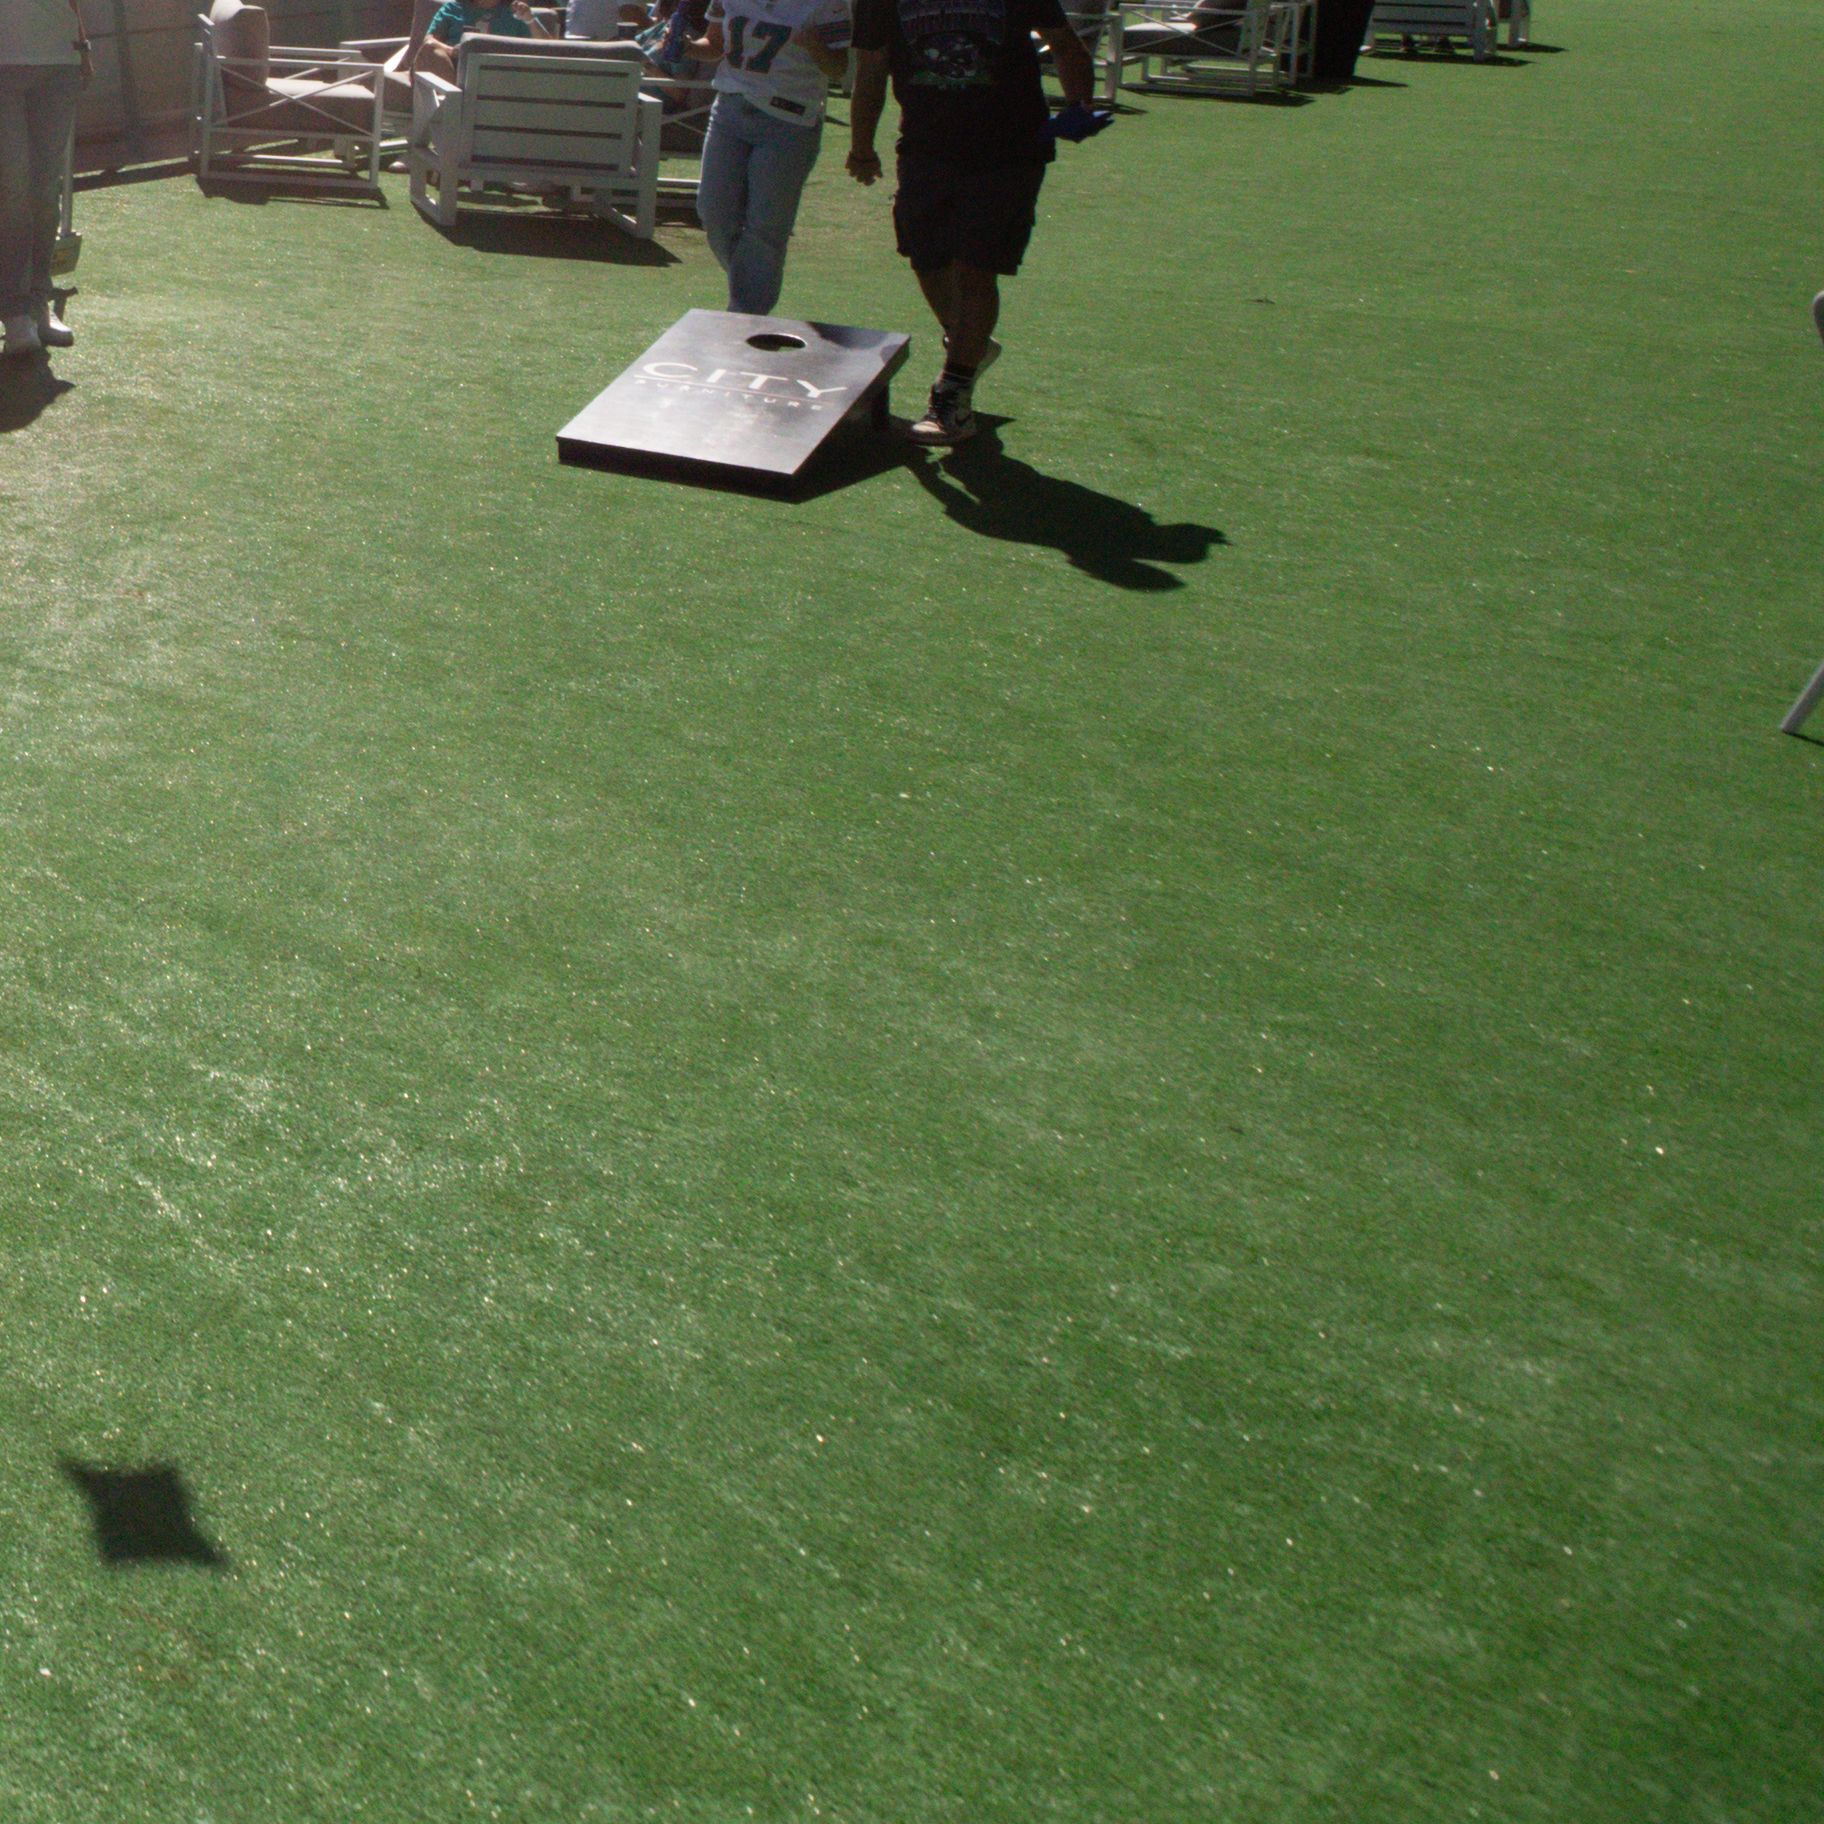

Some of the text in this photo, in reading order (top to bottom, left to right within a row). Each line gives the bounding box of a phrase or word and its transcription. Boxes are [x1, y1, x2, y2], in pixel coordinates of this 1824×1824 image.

[728, 15, 792, 74] 17
[634, 379, 824, 411] FURNITURE
[642, 361, 849, 399] CITY
